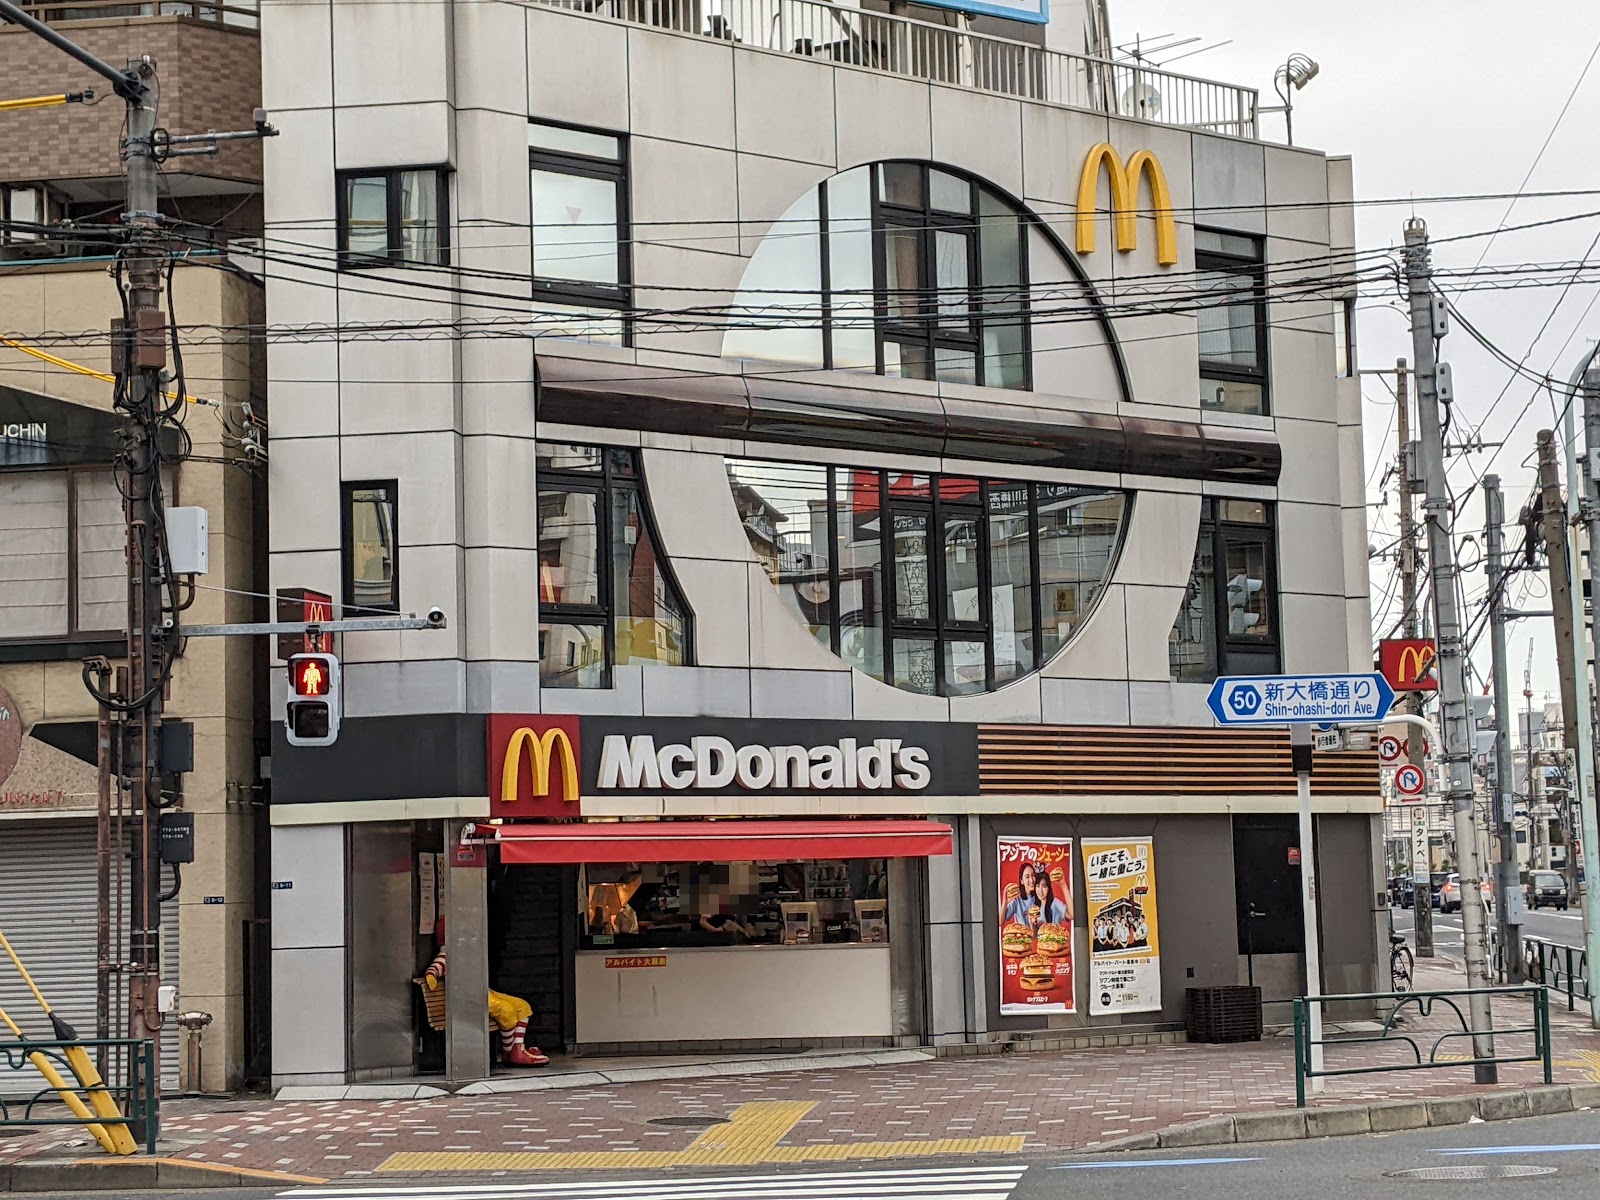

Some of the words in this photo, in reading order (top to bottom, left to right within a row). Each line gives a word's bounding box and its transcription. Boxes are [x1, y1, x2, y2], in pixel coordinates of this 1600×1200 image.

[1233, 690, 1257, 710] 50
[1265, 680, 1370, 702] 新大橋通り
[1265, 700, 1350, 717] Shin-ohashi-dori
[1354, 701, 1375, 715] Ave.
[597, 735, 931, 790] McDonald's
[1416, 828, 1425, 857] タナベ
[1000, 844, 1069, 862] アジアのジューシー
[1091, 850, 1129, 867] いまこそ、
[1089, 860, 1146, 879] 一緒に働こう。
